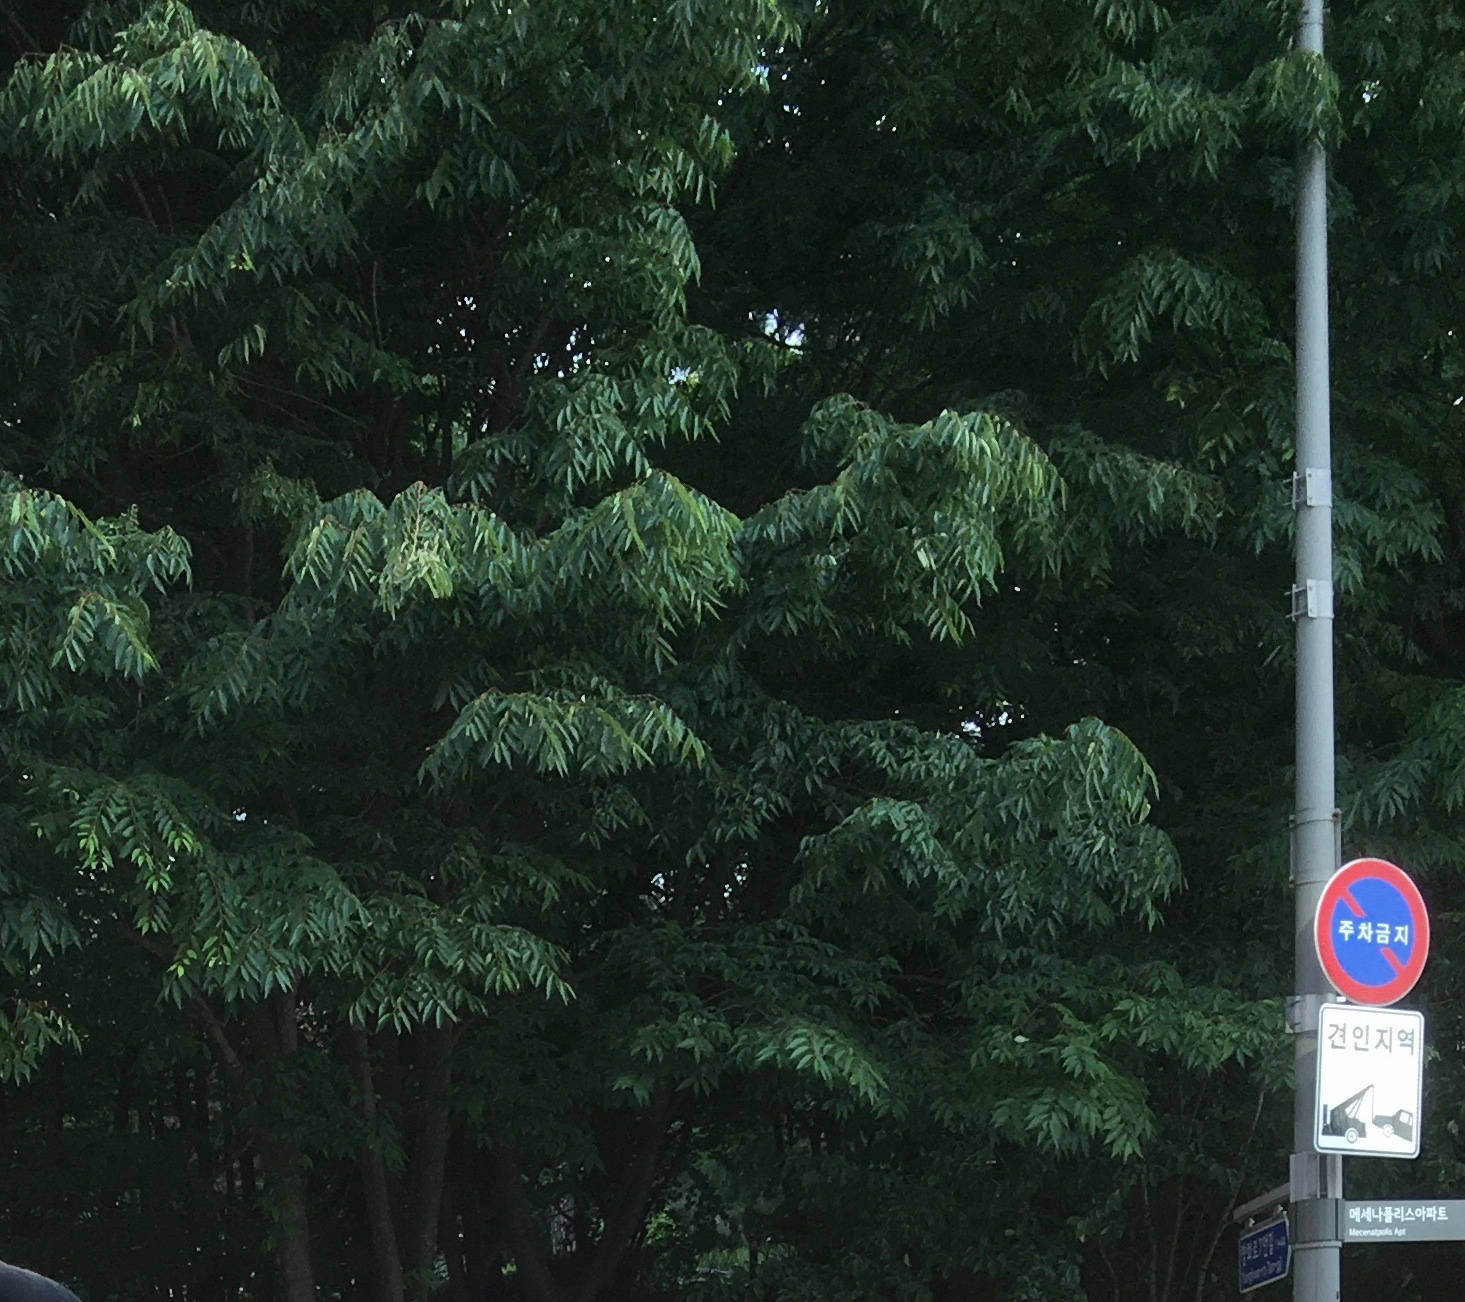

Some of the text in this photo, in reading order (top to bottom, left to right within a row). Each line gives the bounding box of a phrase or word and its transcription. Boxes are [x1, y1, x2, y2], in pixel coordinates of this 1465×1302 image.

[1338, 920, 1408, 944] 주차금지
[1327, 1022, 1415, 1055] 견인지역
[1349, 1205, 1448, 1223] 메세나폴리스아파트
